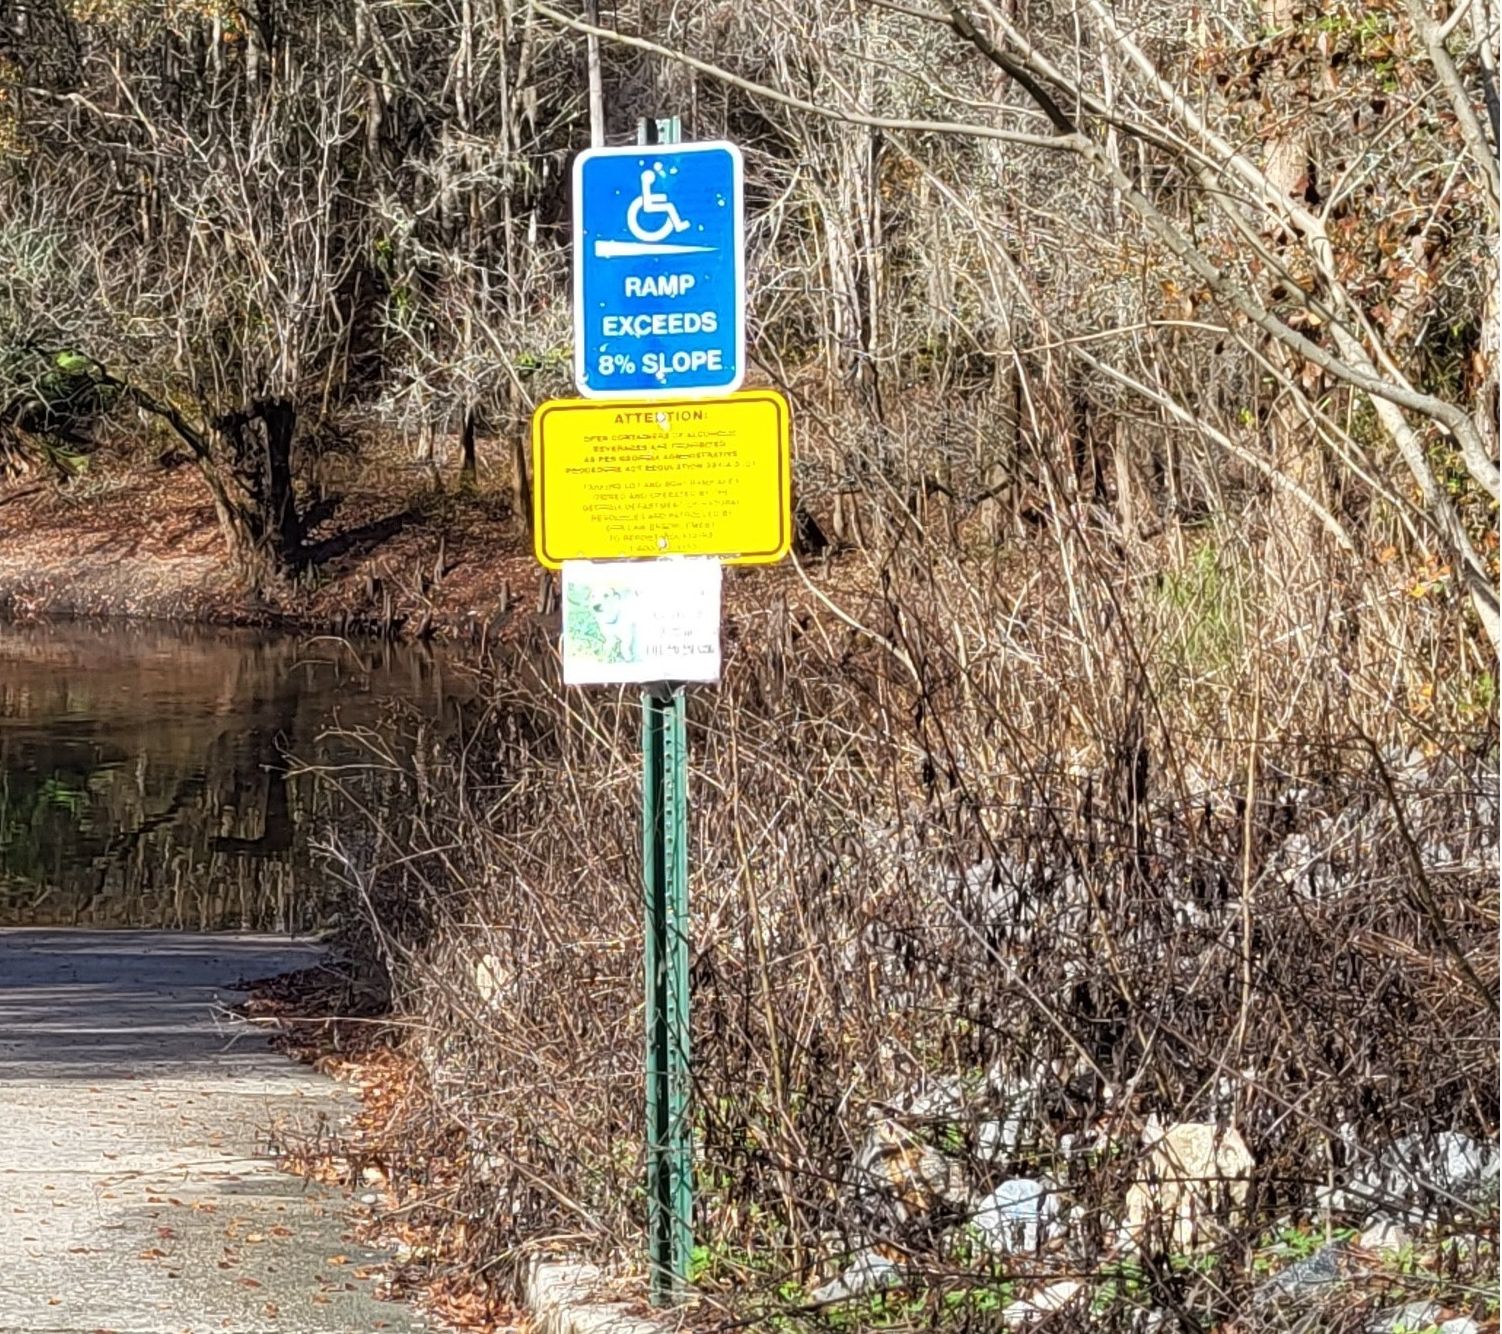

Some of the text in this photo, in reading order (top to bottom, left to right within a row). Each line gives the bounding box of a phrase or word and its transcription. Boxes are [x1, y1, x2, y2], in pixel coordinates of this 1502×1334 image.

[625, 274, 695, 297] RAMP
[603, 311, 717, 337] EXCEEDS
[598, 349, 723, 375] 8% SLOPE
